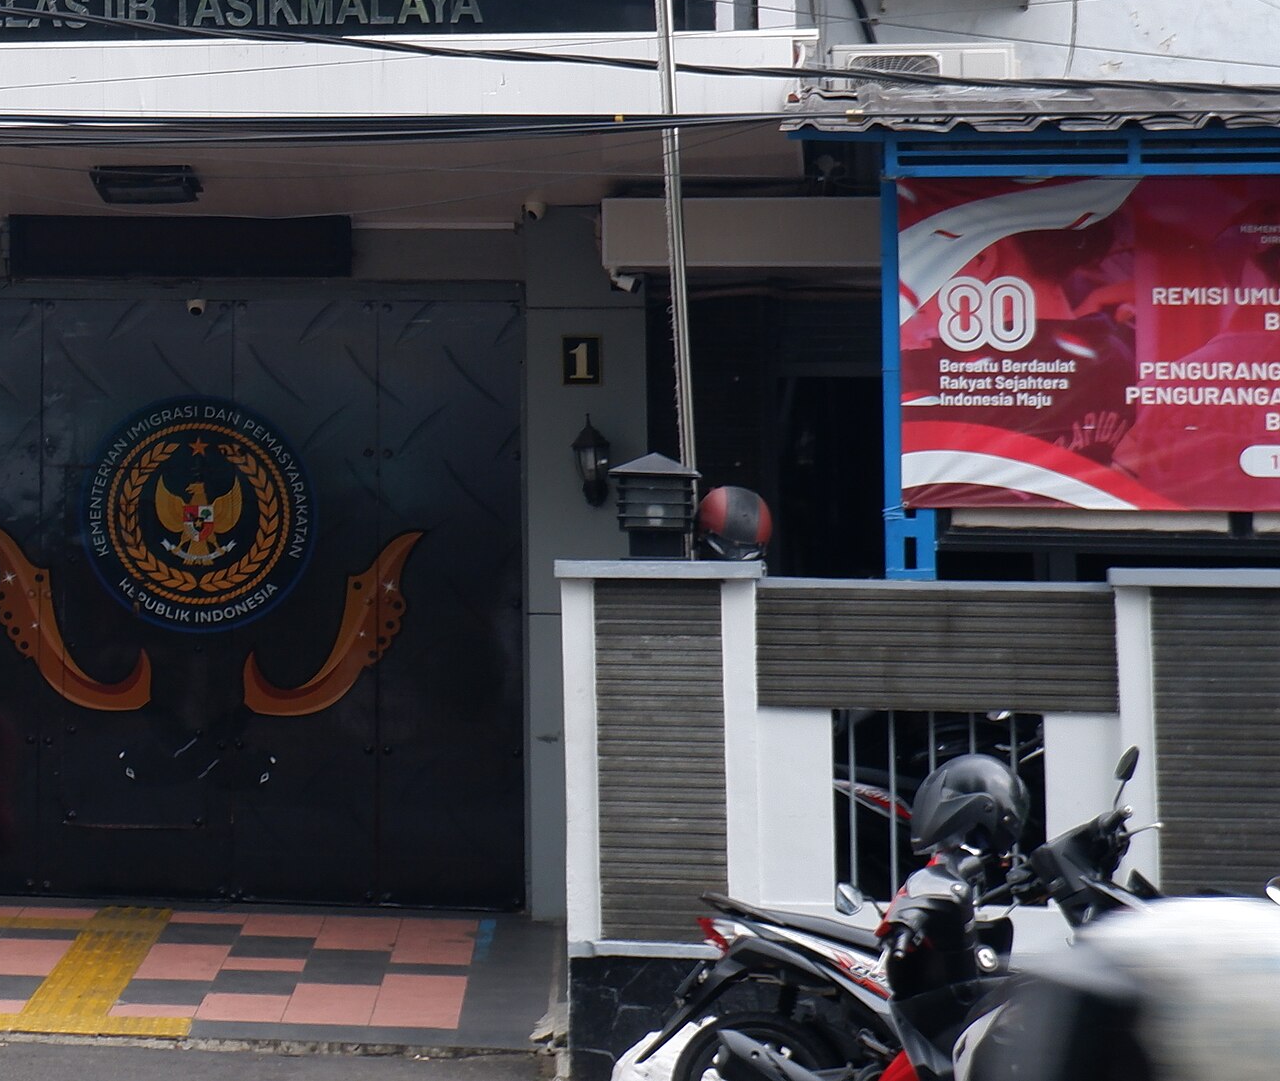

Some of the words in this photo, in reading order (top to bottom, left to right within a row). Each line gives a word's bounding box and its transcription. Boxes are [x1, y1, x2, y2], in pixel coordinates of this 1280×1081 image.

[1152, 287, 1229, 306] REMISI
[938, 276, 1036, 352] 80
[569, 343, 594, 379] 1
[939, 359, 999, 373] Bersatu
[1002, 359, 1076, 373] Berdaulat
[939, 375, 993, 394] Rakyat
[995, 375, 1070, 392] Sejahtera
[939, 392, 1013, 407] Indonesia
[1016, 392, 1053, 410] Maju
[90, 439, 129, 557] KEMENTERIAN
[127, 405, 199, 442] IMIGRASI
[204, 405, 241, 425] DAN
[243, 418, 309, 560] PEMASYARAKATAN
[194, 582, 278, 624] INDONESIA
